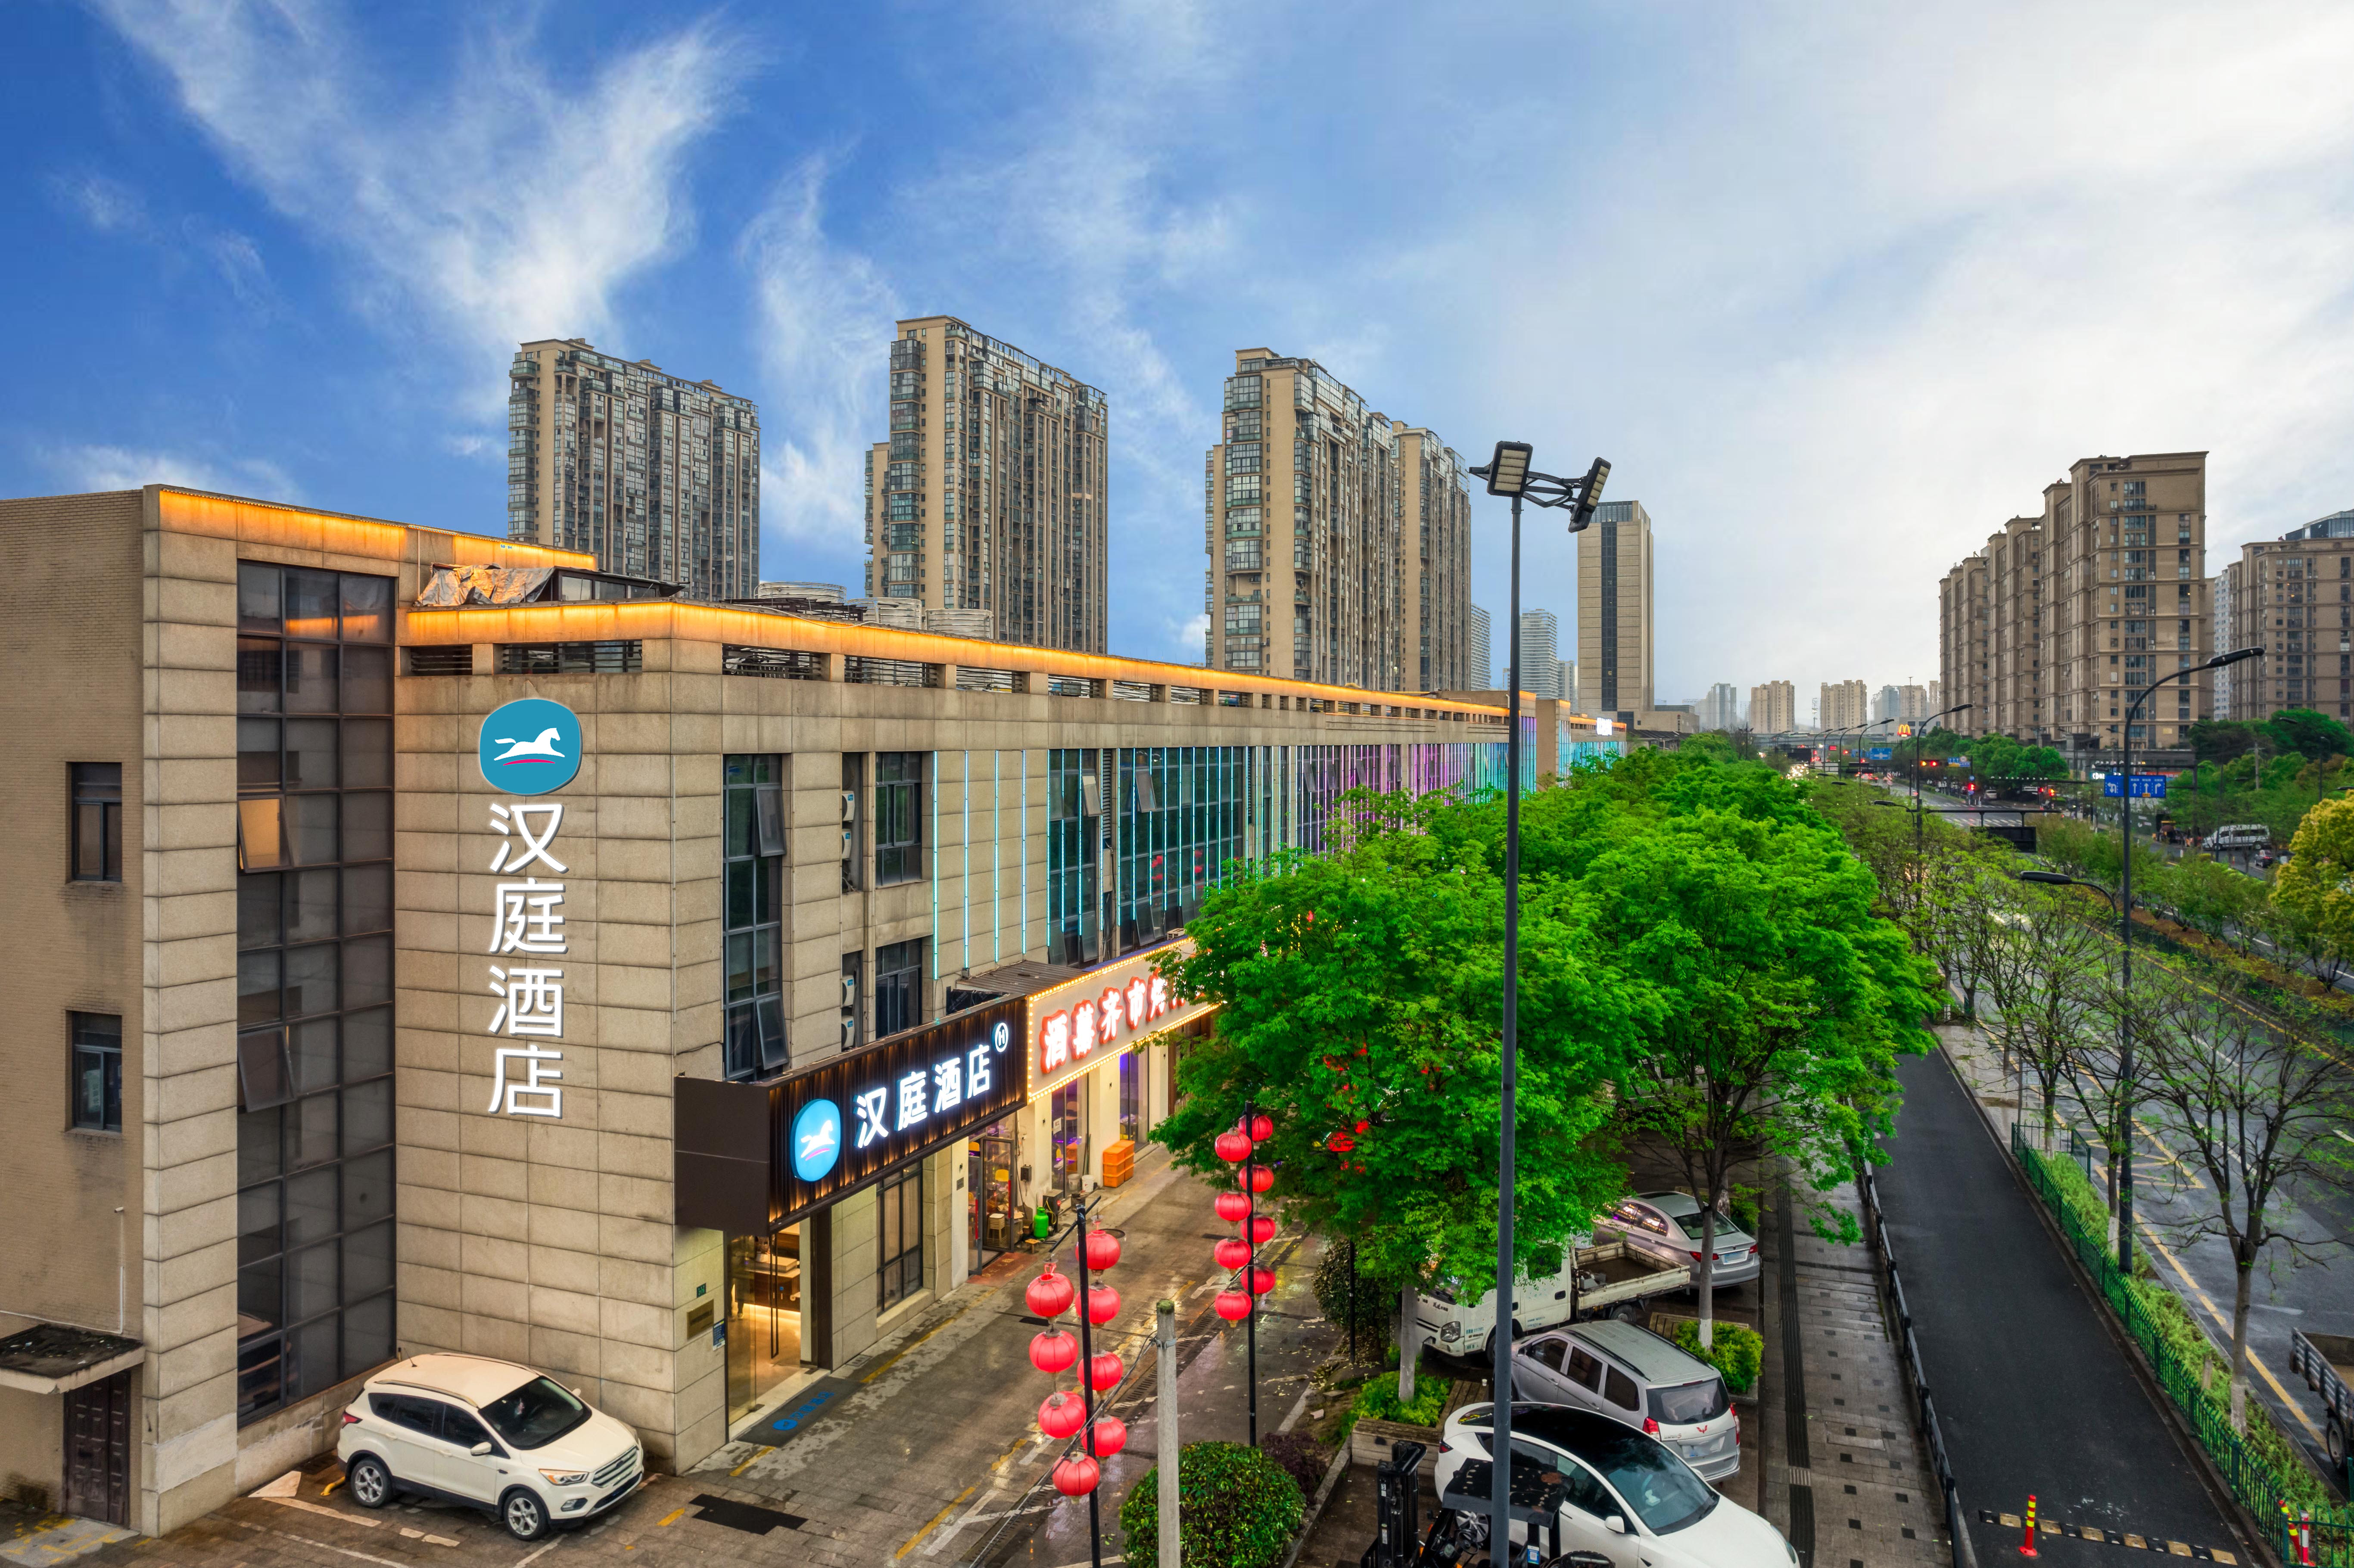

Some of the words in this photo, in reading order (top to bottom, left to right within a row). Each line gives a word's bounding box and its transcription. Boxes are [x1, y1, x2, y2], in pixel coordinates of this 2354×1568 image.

[489, 803, 568, 1118] 汉庭酒店
[854, 1044, 990, 1148] 汉庭酒店
